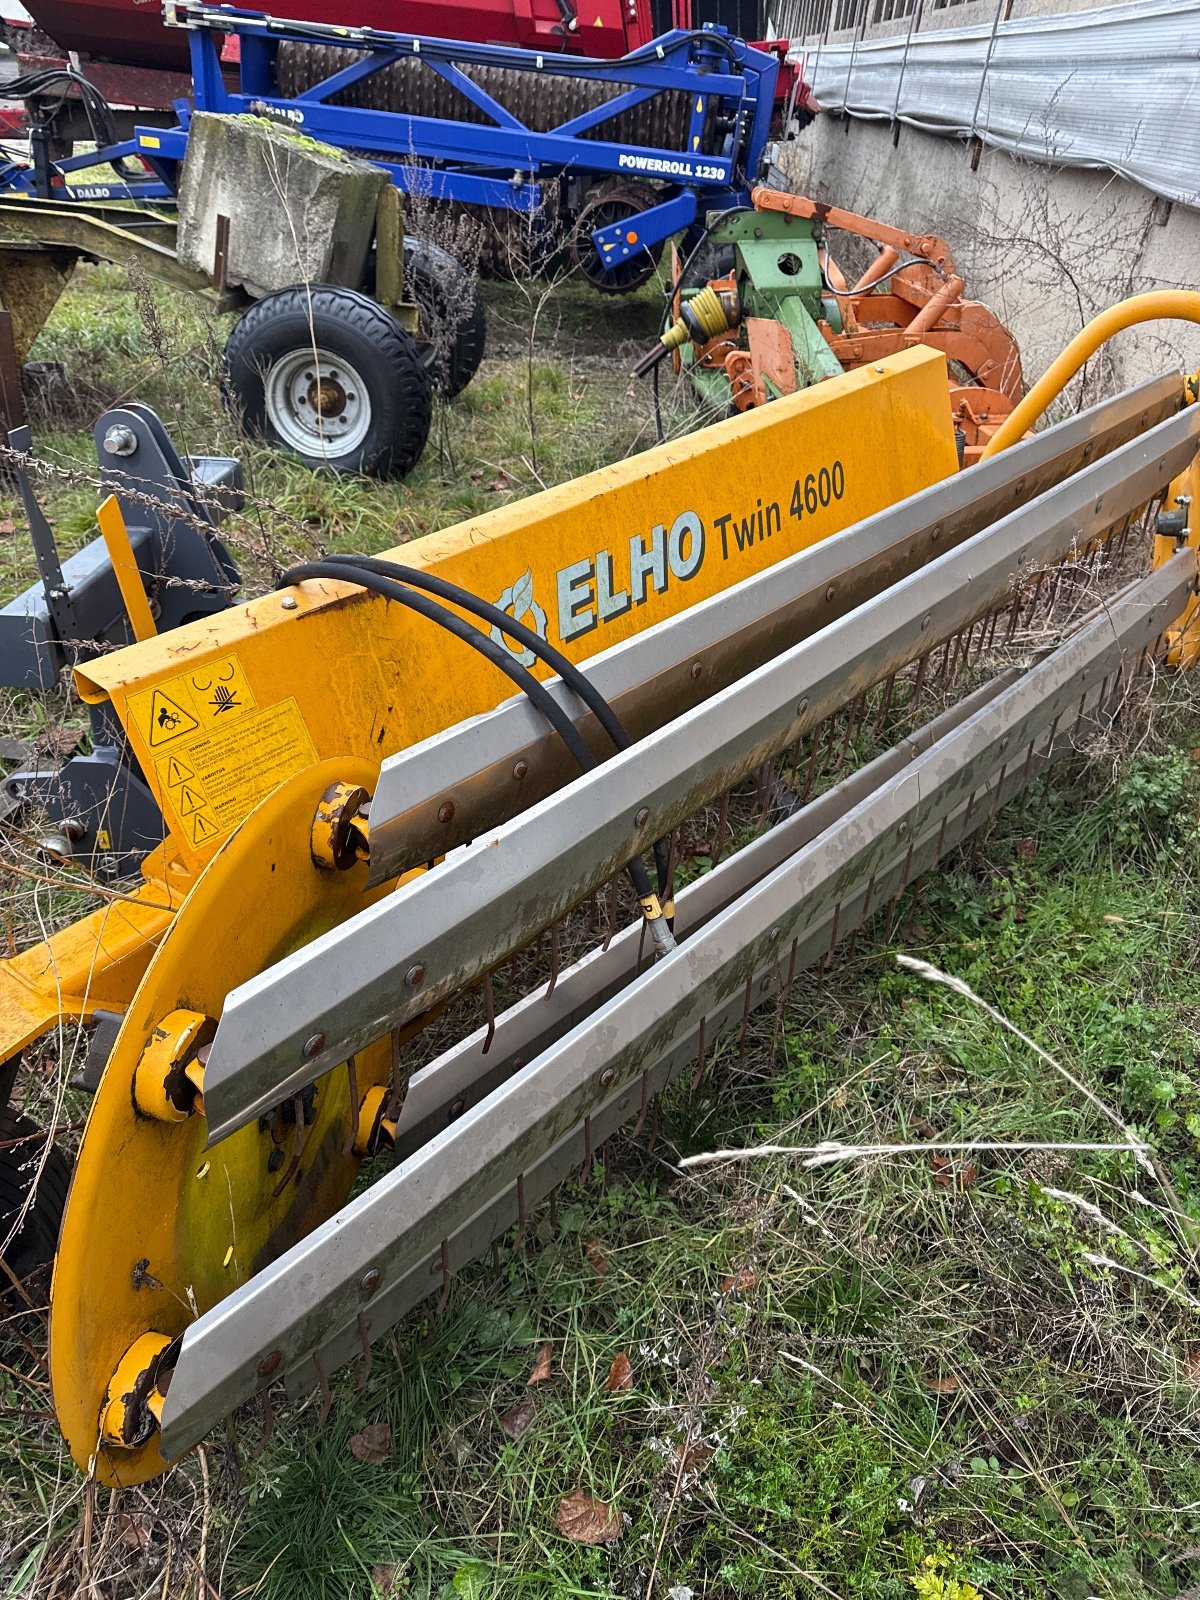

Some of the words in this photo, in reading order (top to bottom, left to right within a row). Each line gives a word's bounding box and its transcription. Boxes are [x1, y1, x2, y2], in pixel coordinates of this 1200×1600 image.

[619, 154, 692, 176] POWERROLL
[695, 165, 725, 181] 1230
[76, 187, 110, 199] DALBO
[556, 509, 705, 643] ELHO
[713, 498, 781, 560] Twin
[789, 460, 845, 521] 4600
[214, 797, 237, 810] WARNING
